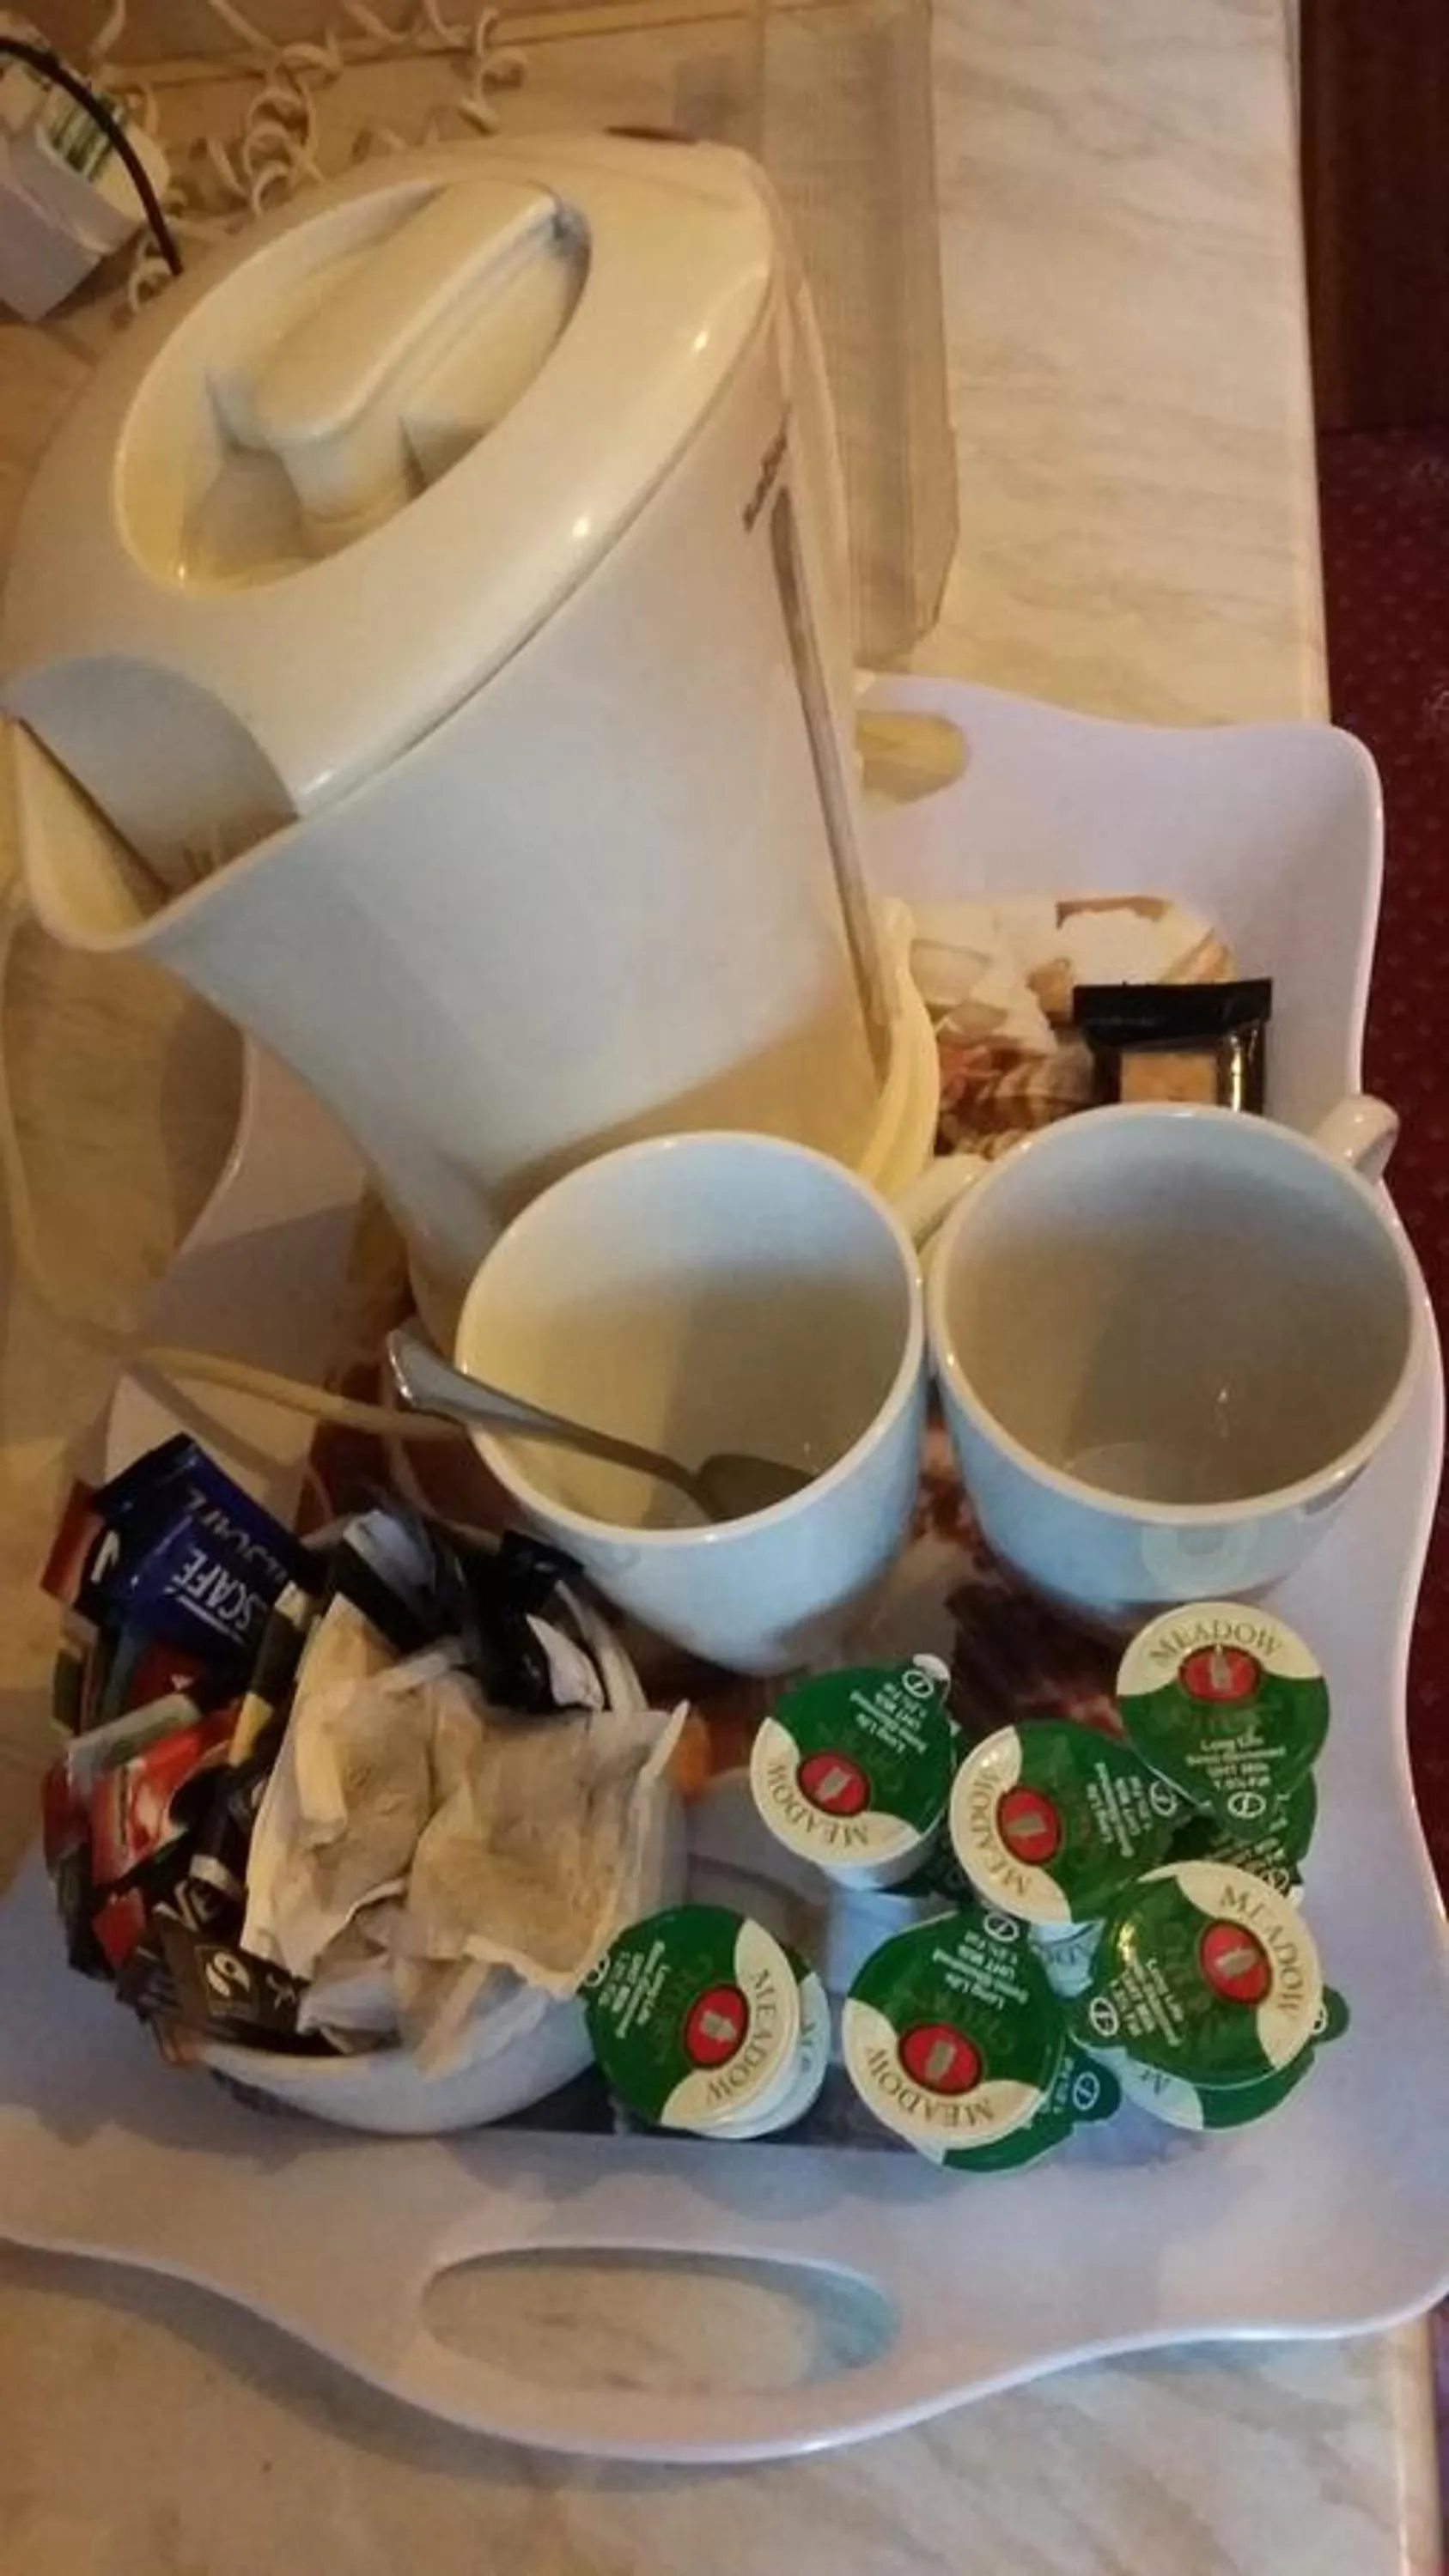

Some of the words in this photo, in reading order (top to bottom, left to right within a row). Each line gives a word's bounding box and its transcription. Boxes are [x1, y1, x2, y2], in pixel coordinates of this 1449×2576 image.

[163, 1545, 268, 1630] SCAFÉ
[1151, 1622, 1282, 1666] MEADOW
[764, 1765, 869, 1847] MEADOW
[971, 1771, 1031, 1897] MEADOW
[708, 1970, 776, 2099] MEADOW
[867, 2045, 995, 2126] MEADOW
